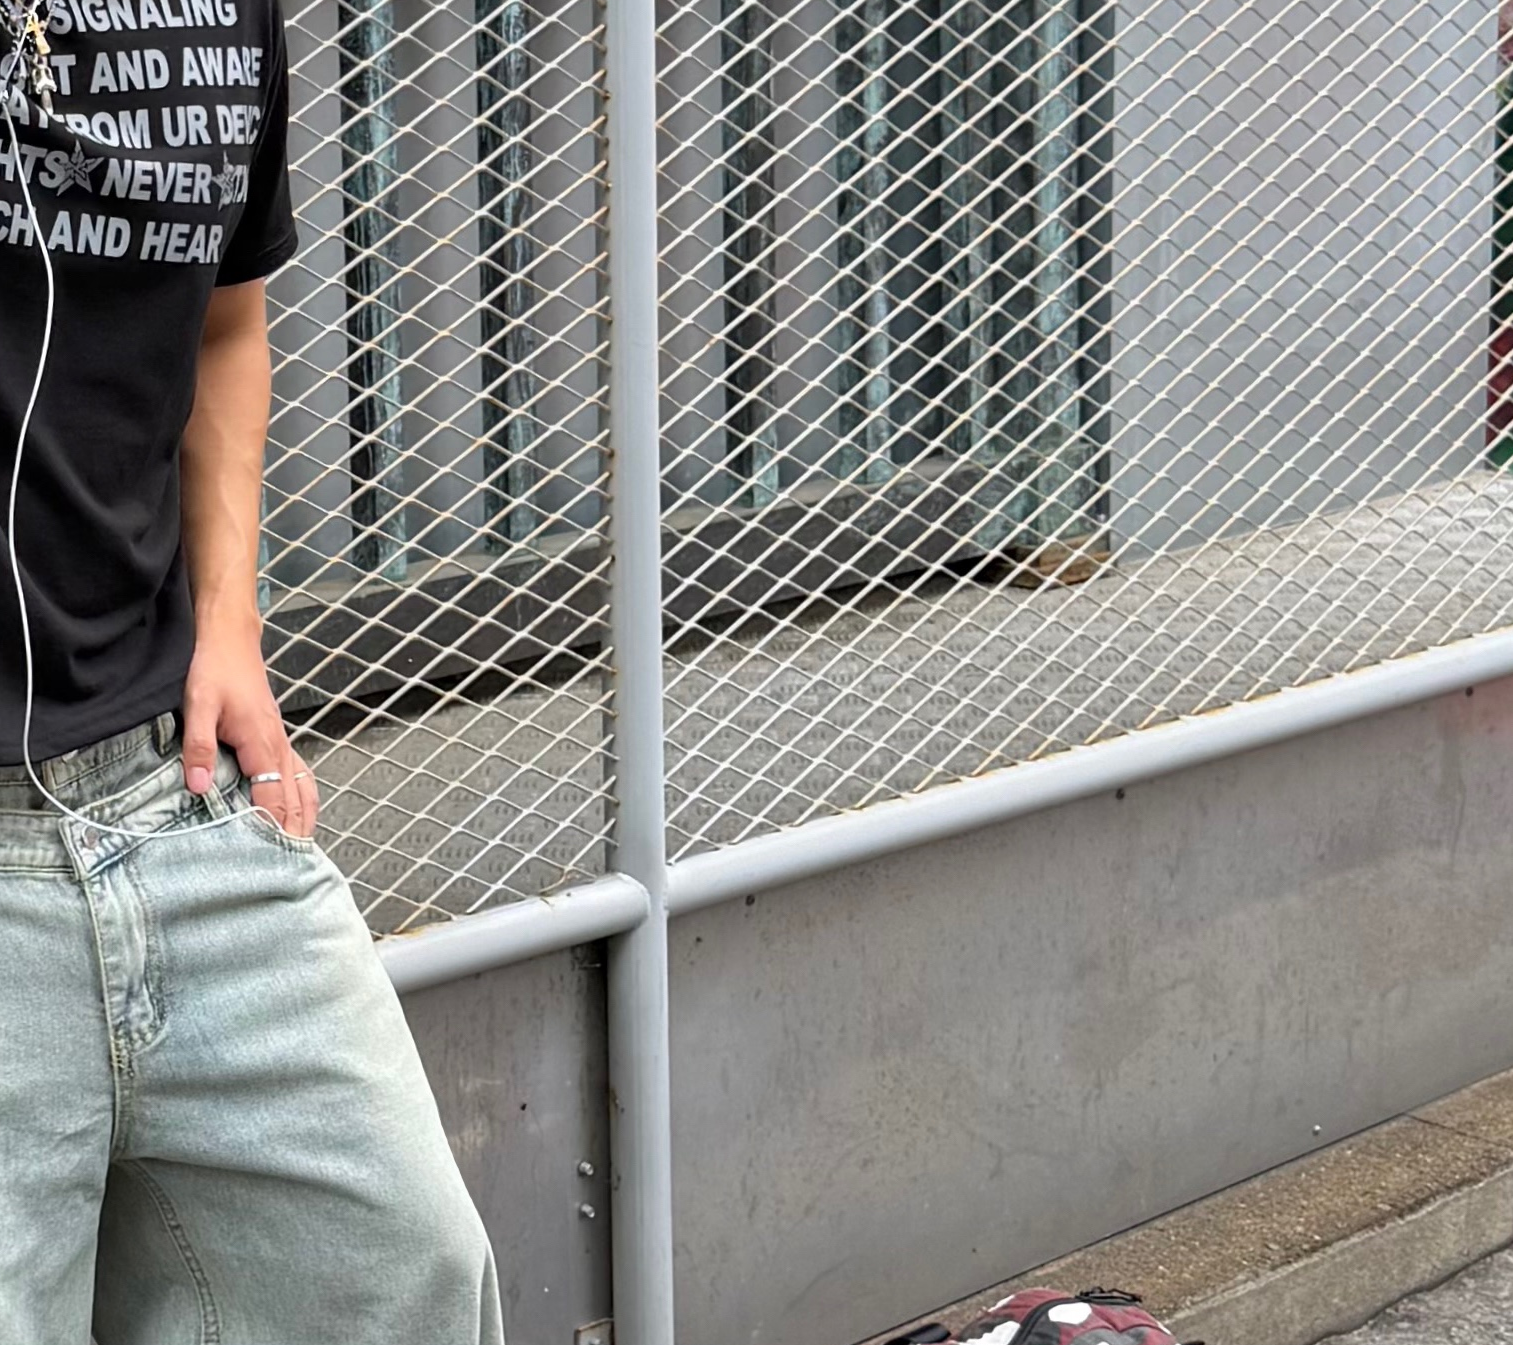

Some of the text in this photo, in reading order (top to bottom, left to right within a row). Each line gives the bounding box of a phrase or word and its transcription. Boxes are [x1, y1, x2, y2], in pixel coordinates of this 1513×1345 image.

[89, 49, 170, 94] AND
[182, 47, 263, 88] AWARE
[53, 109, 152, 149] ROM
[162, 106, 212, 147] UR
[100, 158, 212, 204] NEVER
[47, 210, 131, 258] AND
[139, 221, 223, 264] HEAR
